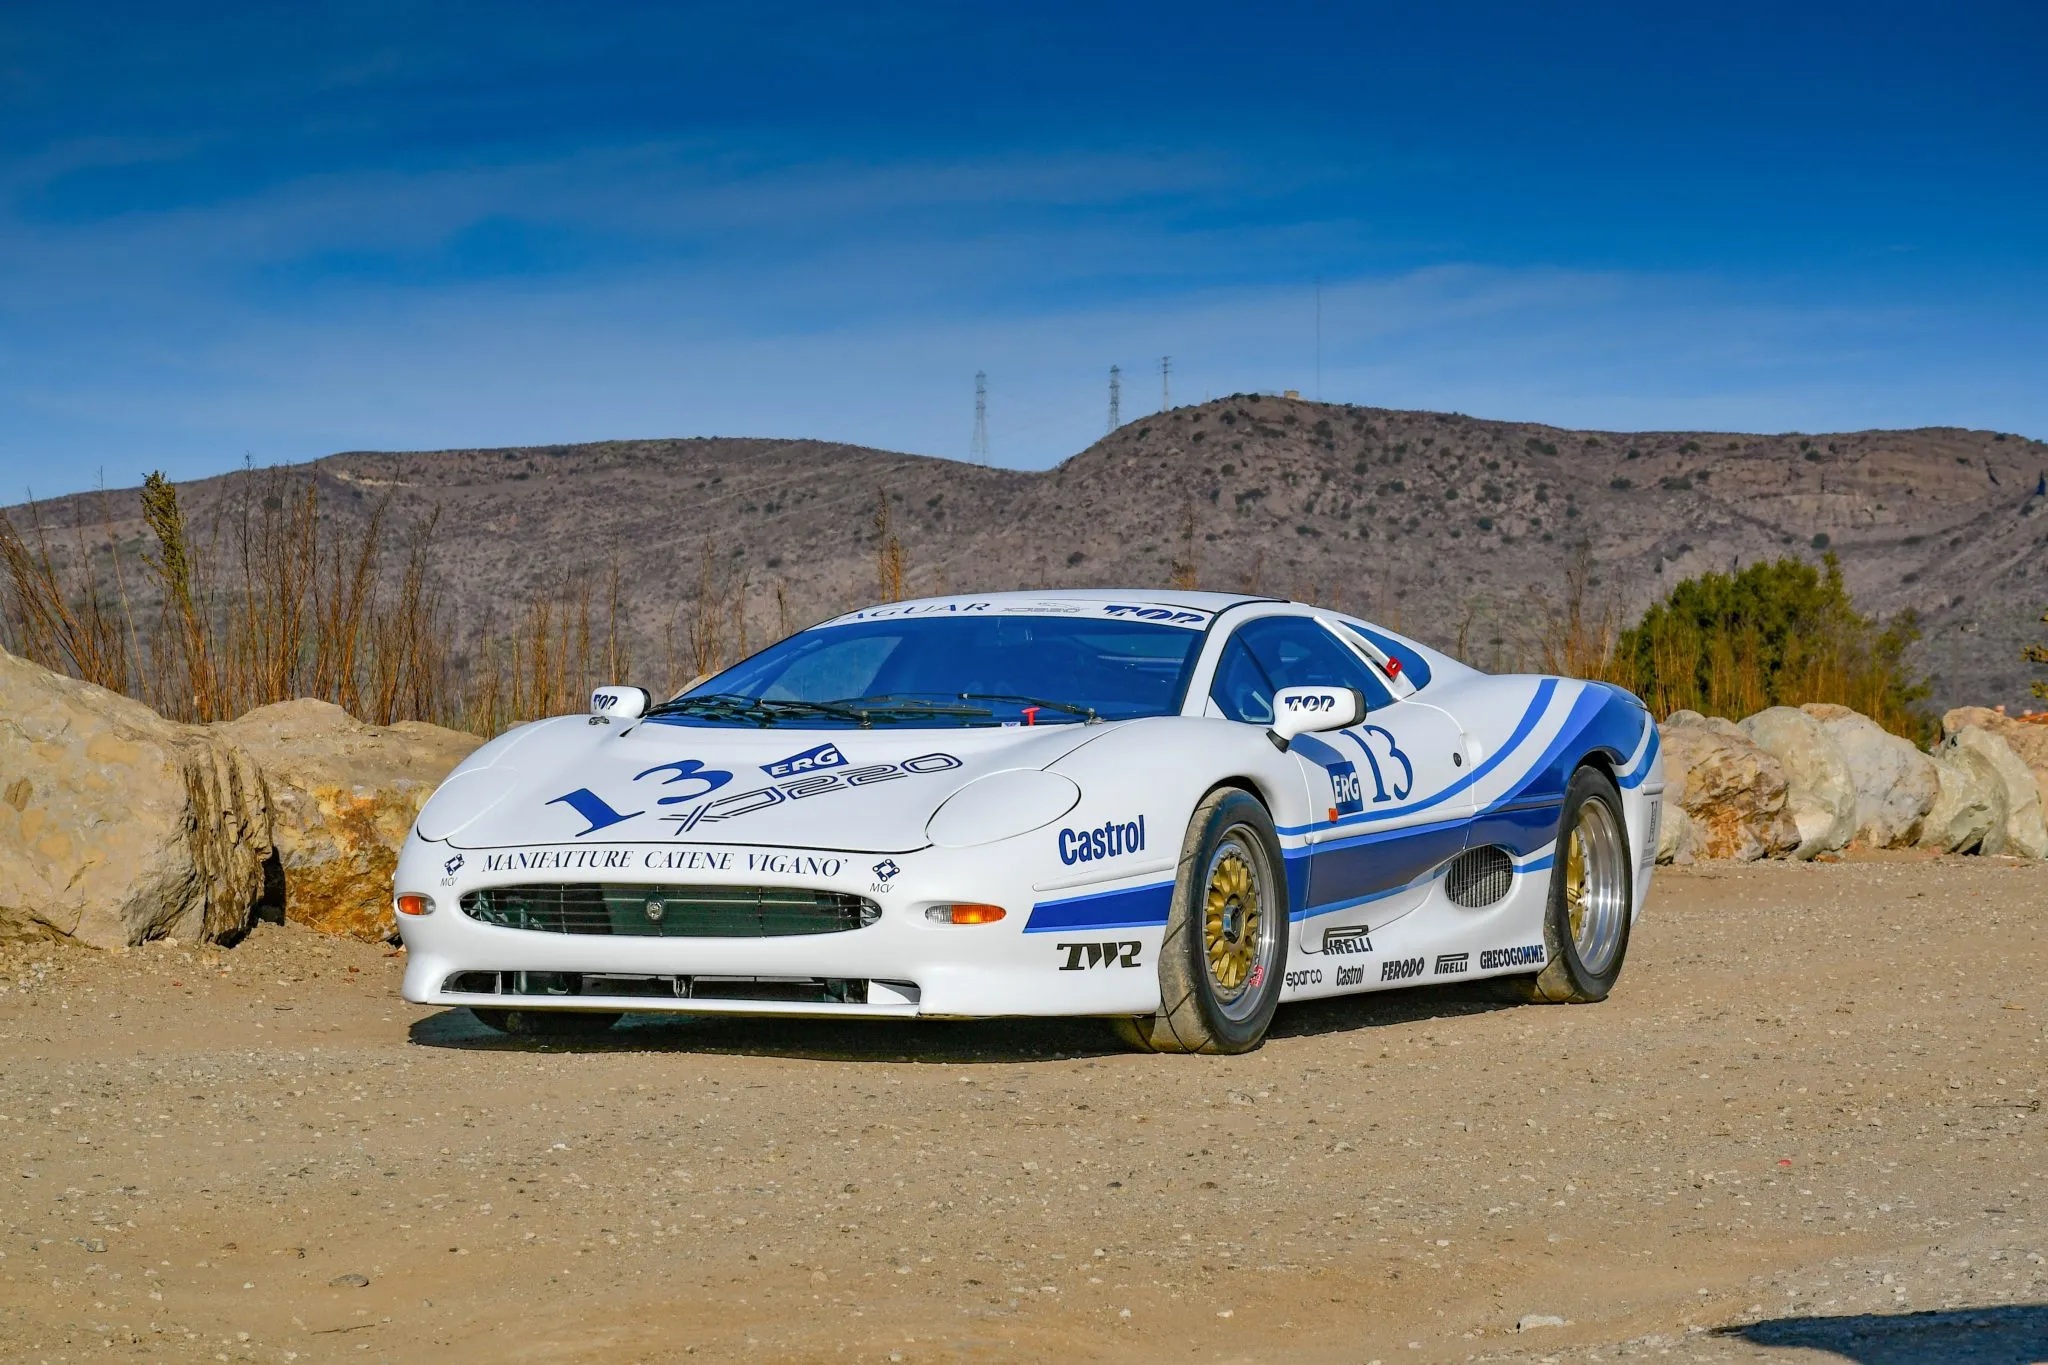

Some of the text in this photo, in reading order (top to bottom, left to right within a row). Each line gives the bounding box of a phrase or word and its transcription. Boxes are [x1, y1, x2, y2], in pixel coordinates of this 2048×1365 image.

[1103, 605, 1205, 623] TOP
[593, 694, 618, 710] TOP
[1285, 695, 1335, 712] TOP
[771, 746, 841, 777] ERG
[1339, 725, 1413, 803] 13
[545, 759, 734, 837] 13
[658, 753, 963, 836] XJ220
[1332, 772, 1360, 804] ERG
[1058, 814, 1145, 866] Castrol
[481, 850, 634, 872] MANIFATTURE
[644, 850, 735, 870] CATENE
[440, 877, 458, 887] MCV
[869, 882, 895, 893] MCV
[1322, 924, 1374, 955] PIRELLI
[1056, 940, 1142, 970] TWR
[1434, 952, 1469, 975] PIRELLI
[1480, 944, 1545, 970] GRECOGOMME
[1286, 968, 1323, 992] sparco
[1336, 964, 1365, 986] Castrol
[1381, 957, 1425, 982] FERODO
